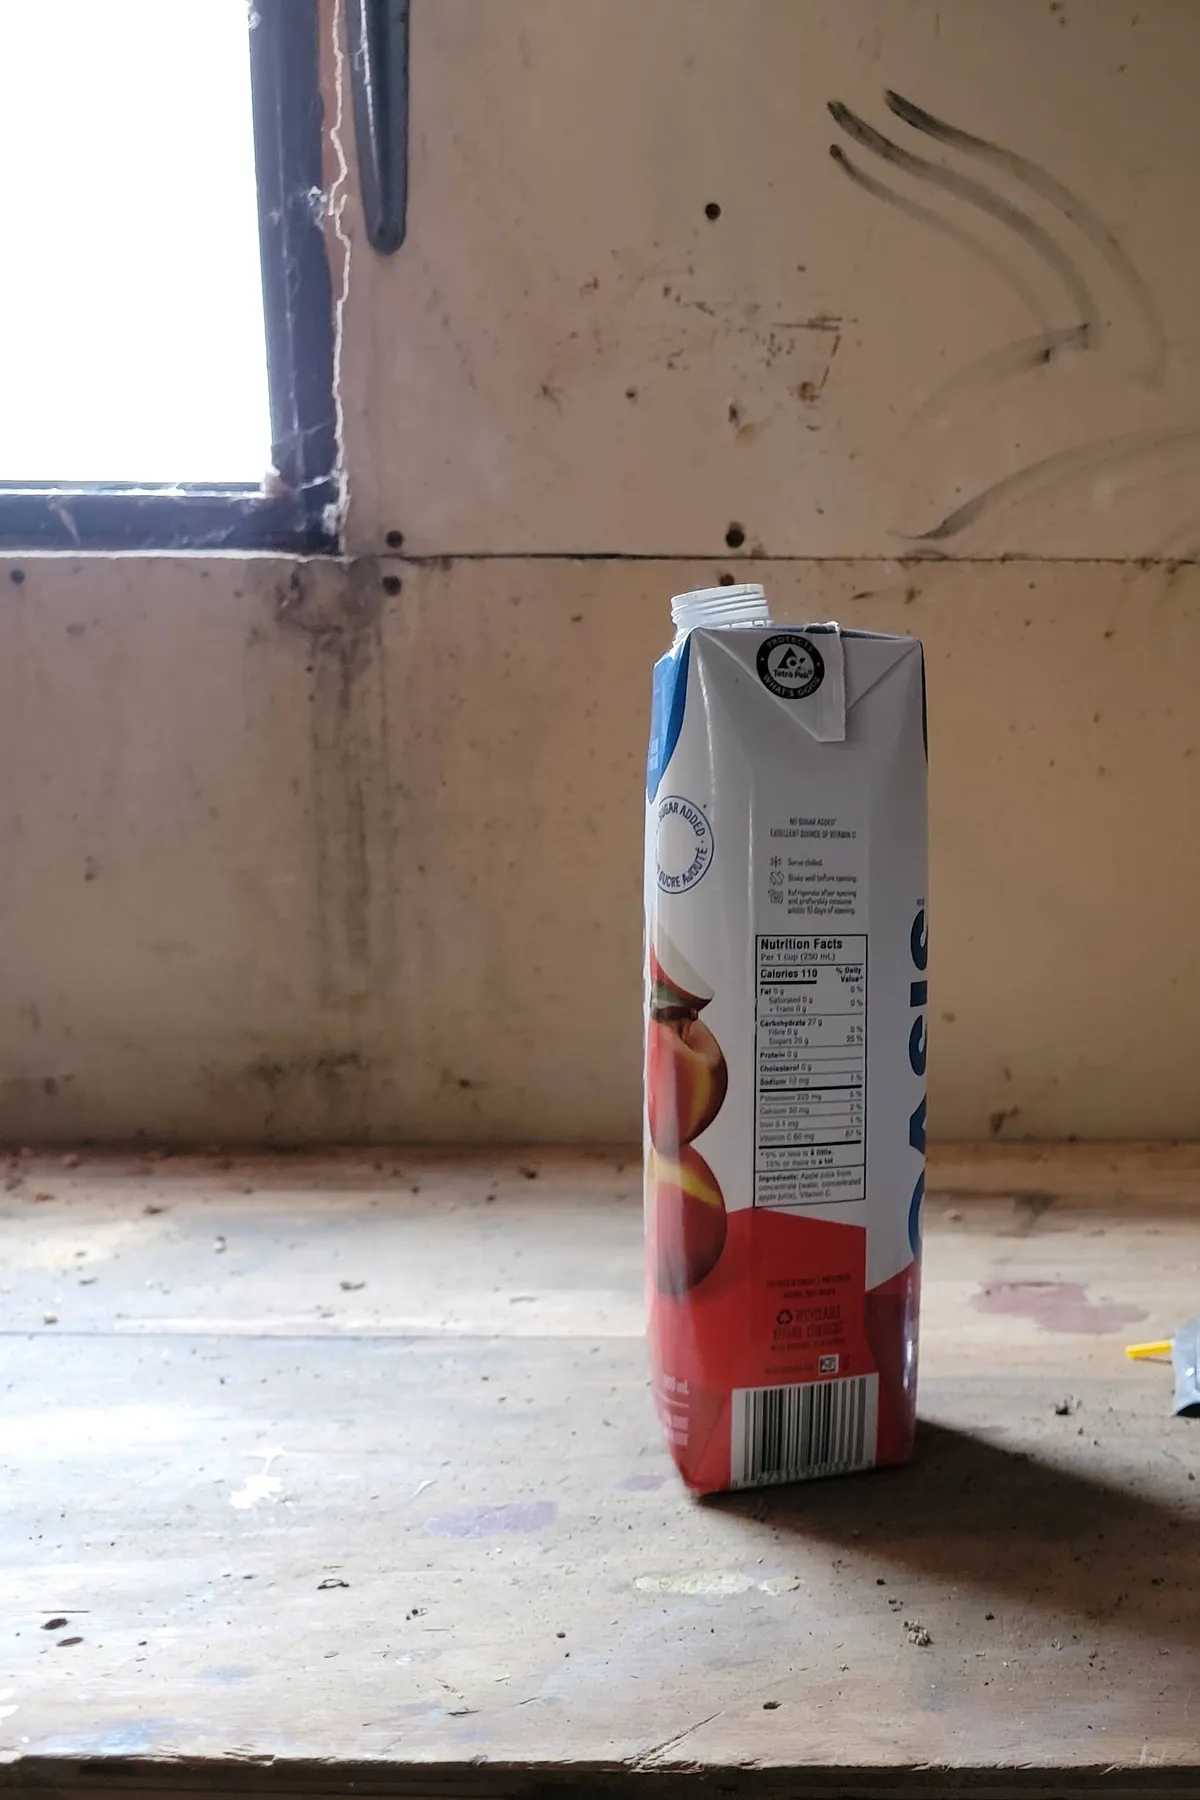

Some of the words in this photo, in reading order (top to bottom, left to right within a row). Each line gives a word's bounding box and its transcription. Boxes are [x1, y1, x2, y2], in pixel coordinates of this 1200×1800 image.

[774, 670, 793, 678] Tetra
[763, 674, 795, 697] WHAT'S
[680, 805, 705, 836] ADDED
[659, 870, 680, 887] SUCRE
[682, 846, 708, 885] AJOUTÉ
[761, 938, 810, 950] Nutrition
[814, 938, 842, 949] Facts
[801, 953, 818, 961] (250
[760, 969, 798, 978] Calories
[802, 969, 818, 978] 110
[760, 988, 772, 996] Fat
[760, 1020, 806, 1028] Carbohydrate
[768, 1038, 792, 1046] Sugars
[760, 1064, 800, 1072] Cholesterol
[799, 1078, 810, 1086] mg
[788, 1120, 798, 1128] mg
[804, 1133, 814, 1141] mg
[801, 1172, 818, 1180] Apple
